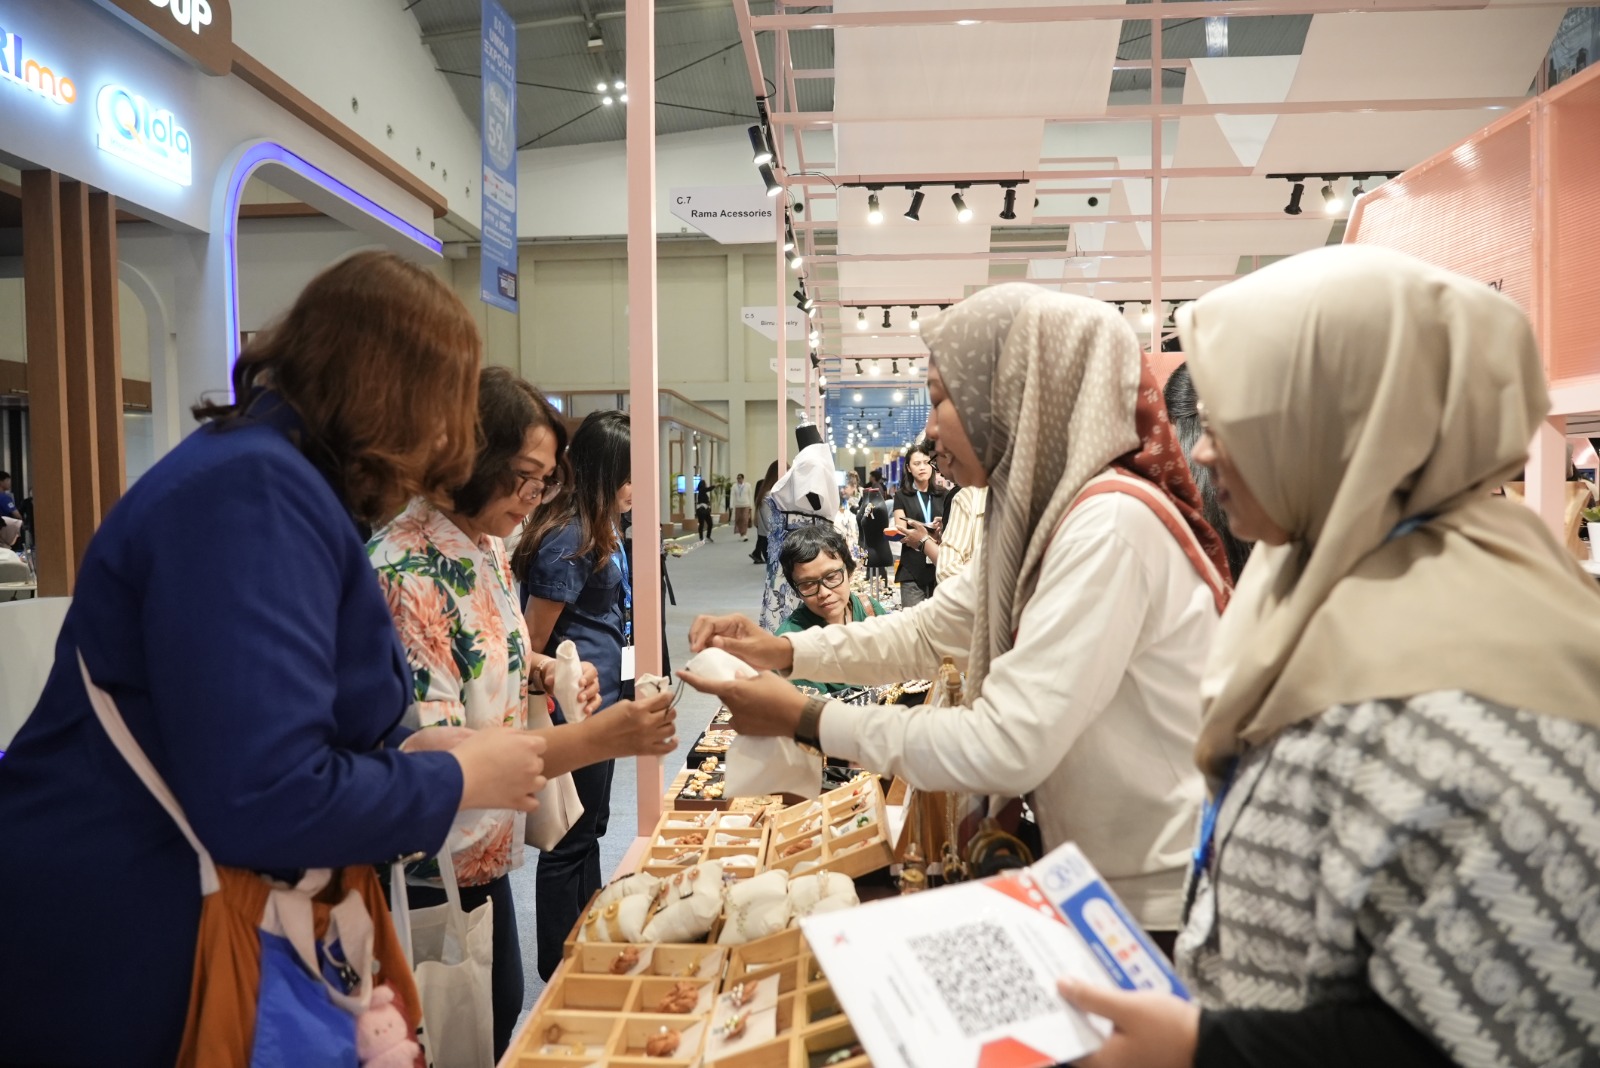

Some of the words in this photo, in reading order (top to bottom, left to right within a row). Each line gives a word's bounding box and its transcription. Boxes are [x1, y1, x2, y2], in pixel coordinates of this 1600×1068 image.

[153, 0, 213, 35] UP
[109, 89, 190, 155] Qlola
[676, 196, 692, 205] C.7
[691, 209, 718, 218] Rama
[720, 208, 772, 218] Acessories
